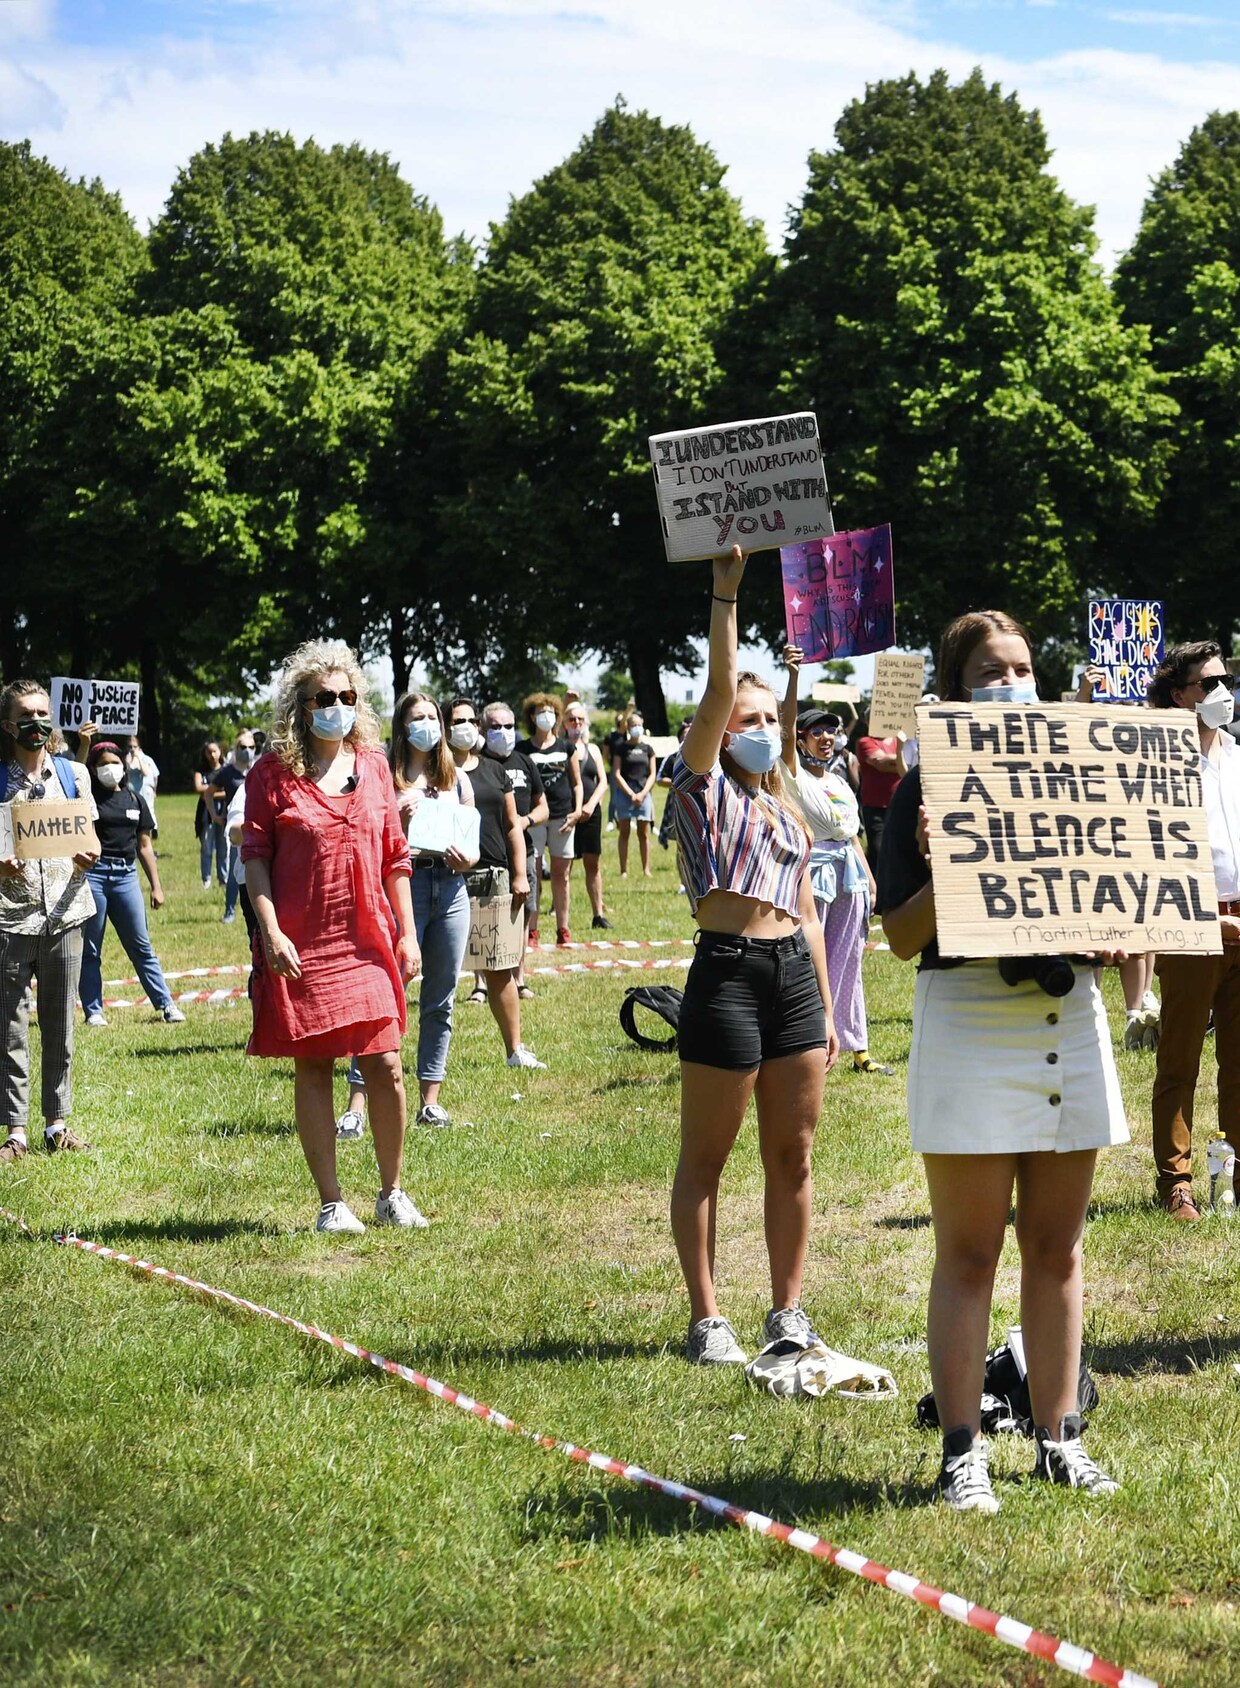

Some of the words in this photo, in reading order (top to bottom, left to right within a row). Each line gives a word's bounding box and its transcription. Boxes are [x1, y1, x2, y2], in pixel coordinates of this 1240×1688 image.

[675, 416, 817, 462] UNDERSTAND
[736, 449, 817, 476] UNDERSTAND
[695, 486, 772, 517] STAND
[773, 478, 826, 501] WITH
[794, 523, 826, 536] #BLM
[807, 548, 872, 583] BLM
[1127, 641, 1160, 666] DICK
[61, 683, 83, 704] NO
[59, 703, 83, 727] NO
[89, 705, 135, 725] PEACE
[1088, 720, 1200, 769] COMES
[959, 764, 996, 805] A
[1012, 925, 1083, 946] Martin
[1086, 921, 1134, 942] Luther
